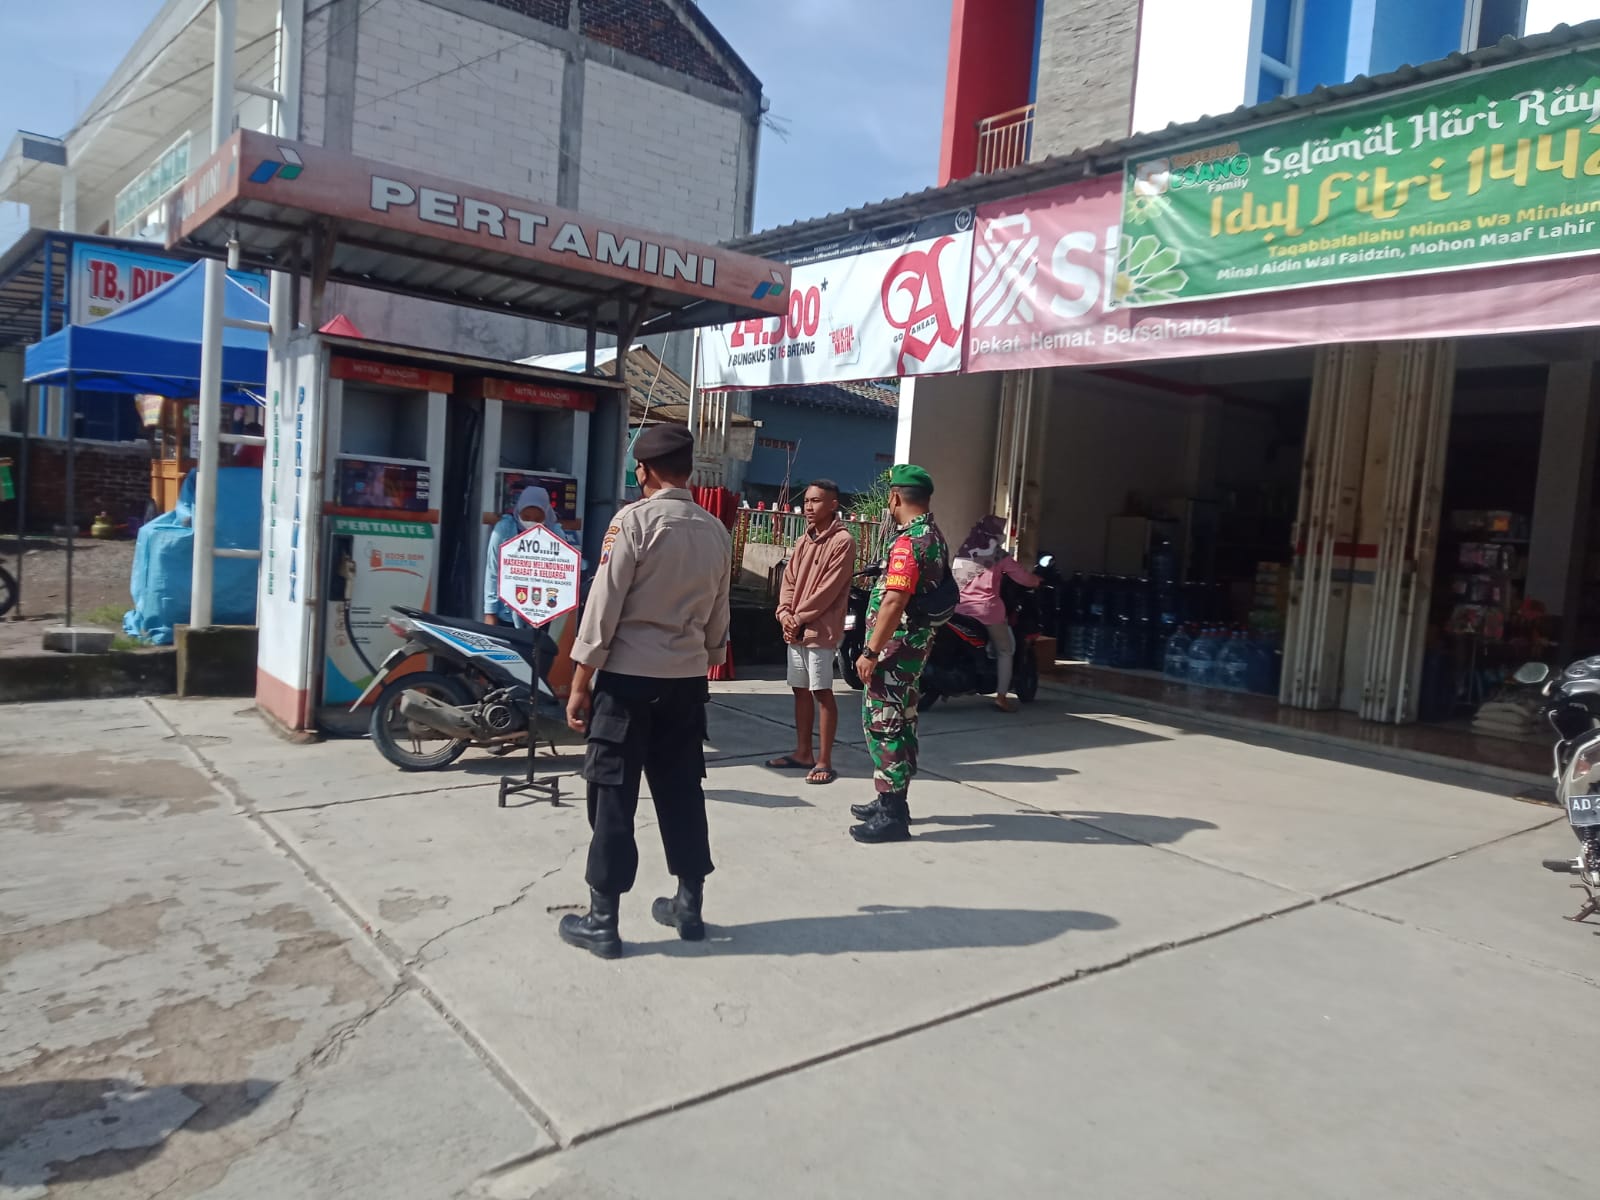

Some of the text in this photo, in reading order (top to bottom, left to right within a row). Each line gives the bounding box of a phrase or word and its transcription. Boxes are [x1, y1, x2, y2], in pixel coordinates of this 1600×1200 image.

[1207, 178, 1249, 193] Family
[370, 174, 717, 288] PERTAMINI
[1409, 220, 1472, 238] Minna
[1477, 213, 1510, 229] Wa
[1216, 218, 1596, 281] Minal Aidin Wal Faidzin, Mohon Maaf Lahir
[88, 258, 125, 303] TB.
[911, 316, 936, 335] AHEAD
[970, 315, 1238, 355] Dekat. Hemat. Bersahabat.
[893, 332, 904, 343] GO
[767, 347, 777, 361] ISI
[778, 345, 786, 359] 16
[787, 341, 816, 357] BATANG
[335, 520, 426, 535] PERTALITE
[1573, 798, 1592, 811] AD
